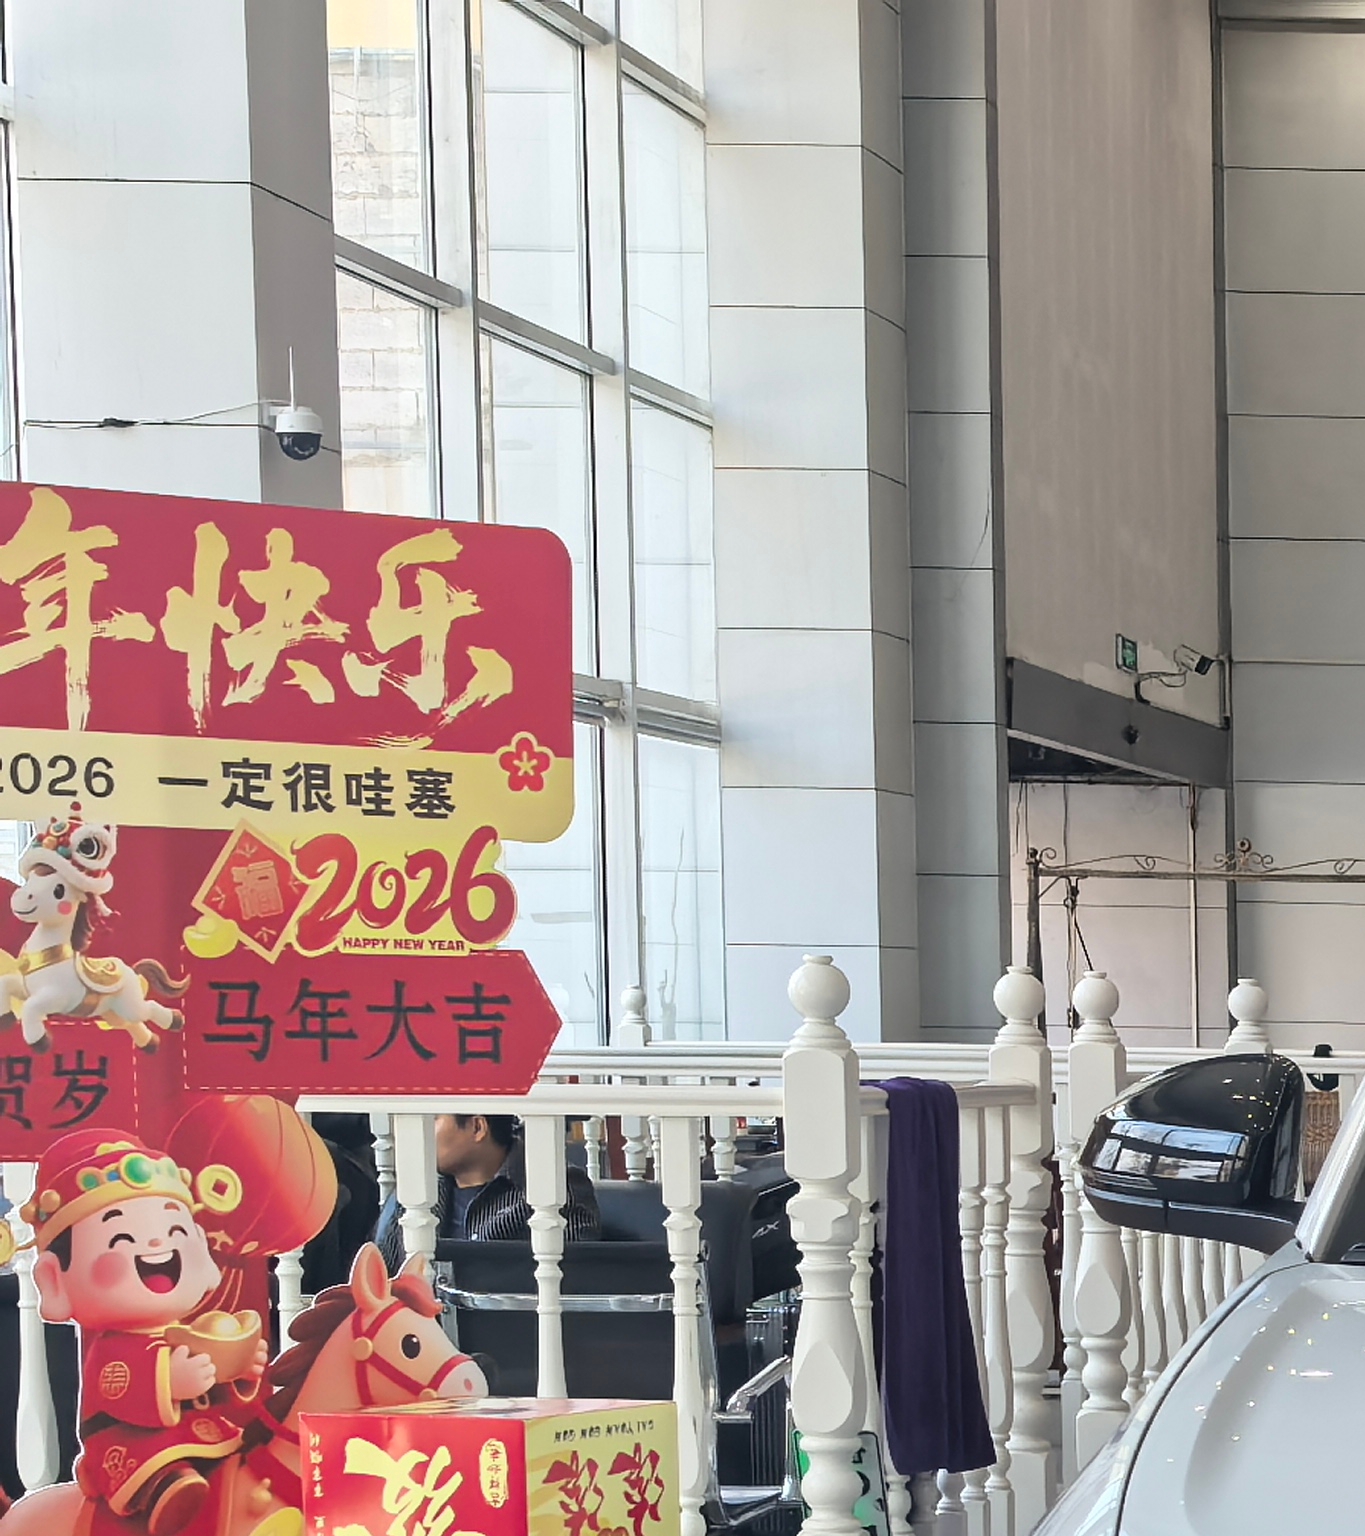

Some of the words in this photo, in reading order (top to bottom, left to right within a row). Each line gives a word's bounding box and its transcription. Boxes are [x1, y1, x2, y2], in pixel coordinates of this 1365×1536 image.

[0, 752, 115, 798] 026
[157, 758, 457, 819] 一定很哇塞
[231, 859, 285, 921] 福
[290, 824, 519, 951] 2026
[342, 936, 389, 949] HAPPY
[393, 937, 424, 951] NEW
[427, 939, 466, 952] YEAR
[203, 976, 512, 1064] 马年大吉
